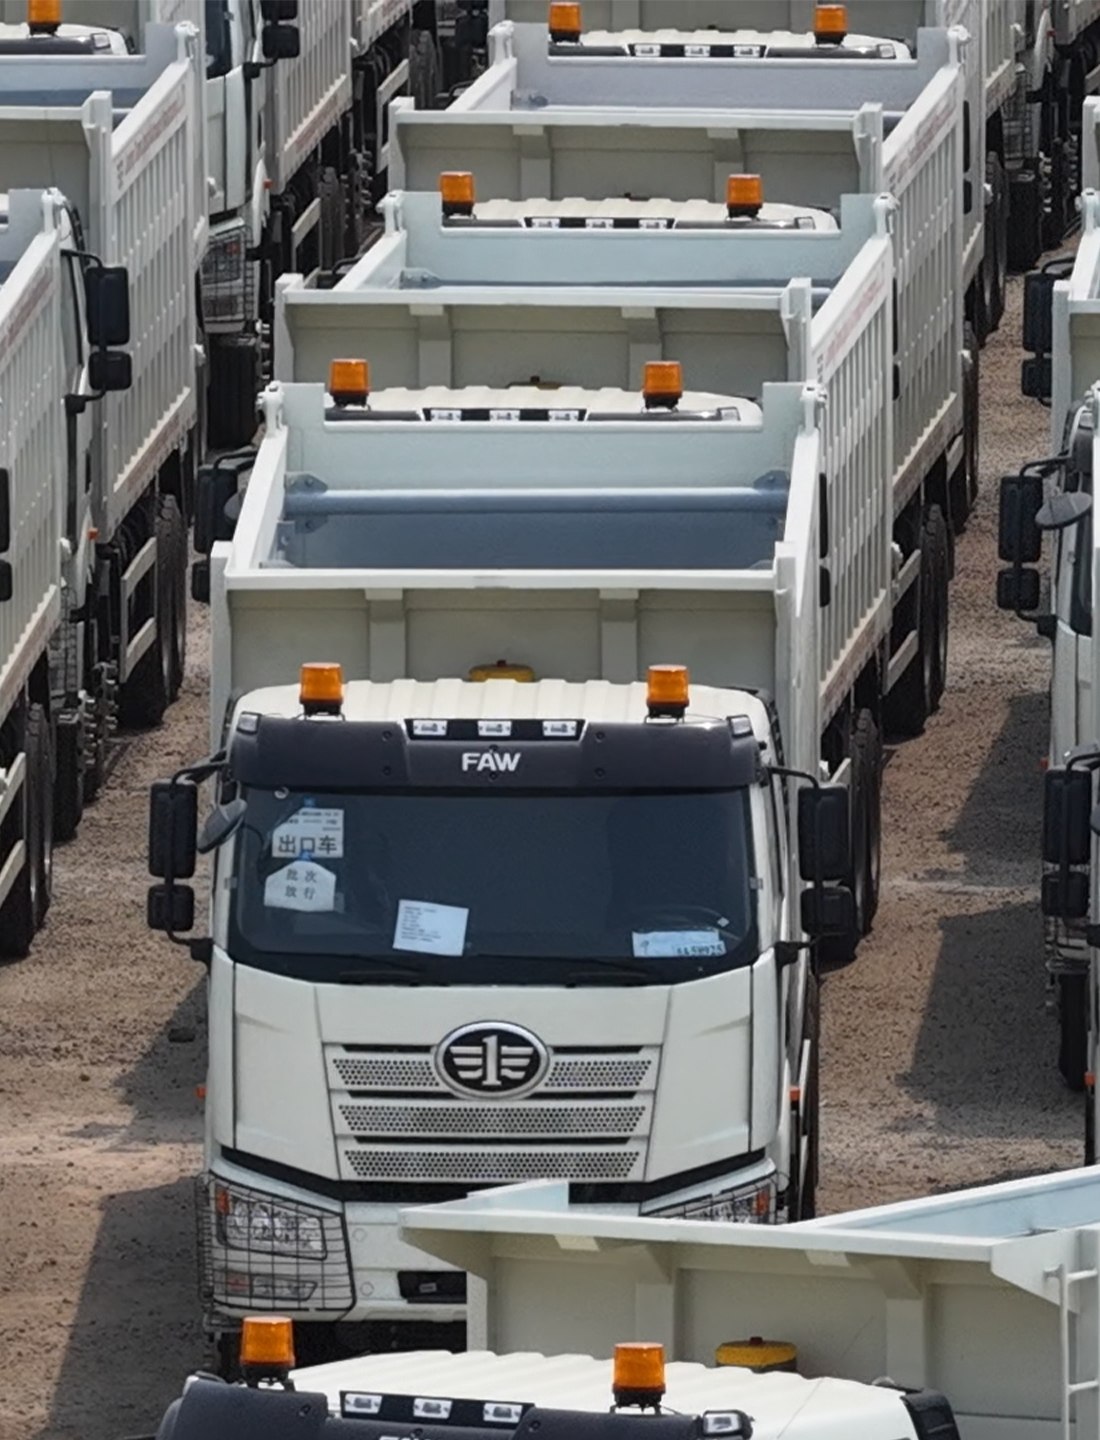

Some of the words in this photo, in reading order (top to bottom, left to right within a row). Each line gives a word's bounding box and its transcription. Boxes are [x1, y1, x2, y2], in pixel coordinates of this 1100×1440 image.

[462, 752, 521, 771] FAW
[278, 834, 338, 855] 出口车
